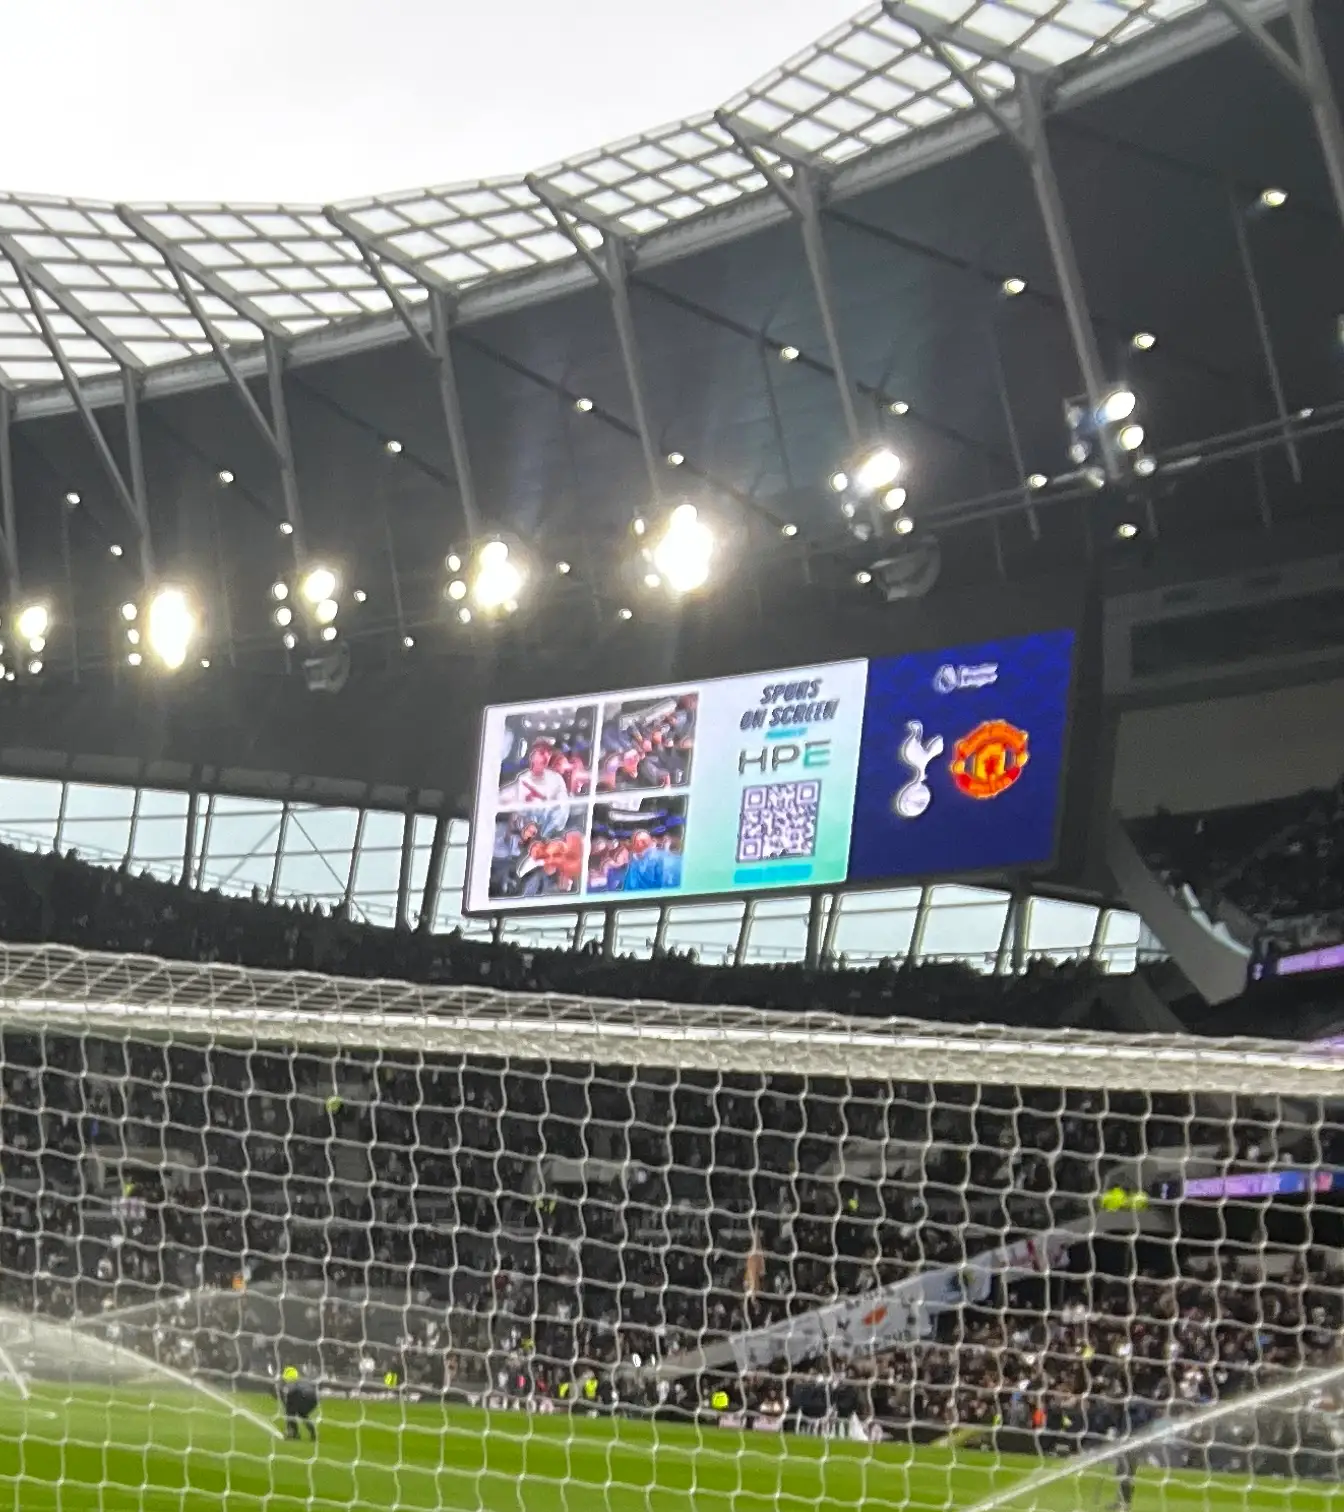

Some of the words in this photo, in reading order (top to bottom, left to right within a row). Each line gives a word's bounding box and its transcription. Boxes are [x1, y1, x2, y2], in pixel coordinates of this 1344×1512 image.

[759, 679, 823, 705] SPURS
[739, 708, 768, 730] ON
[768, 698, 840, 727] SCREEN
[738, 739, 831, 774] HPE
